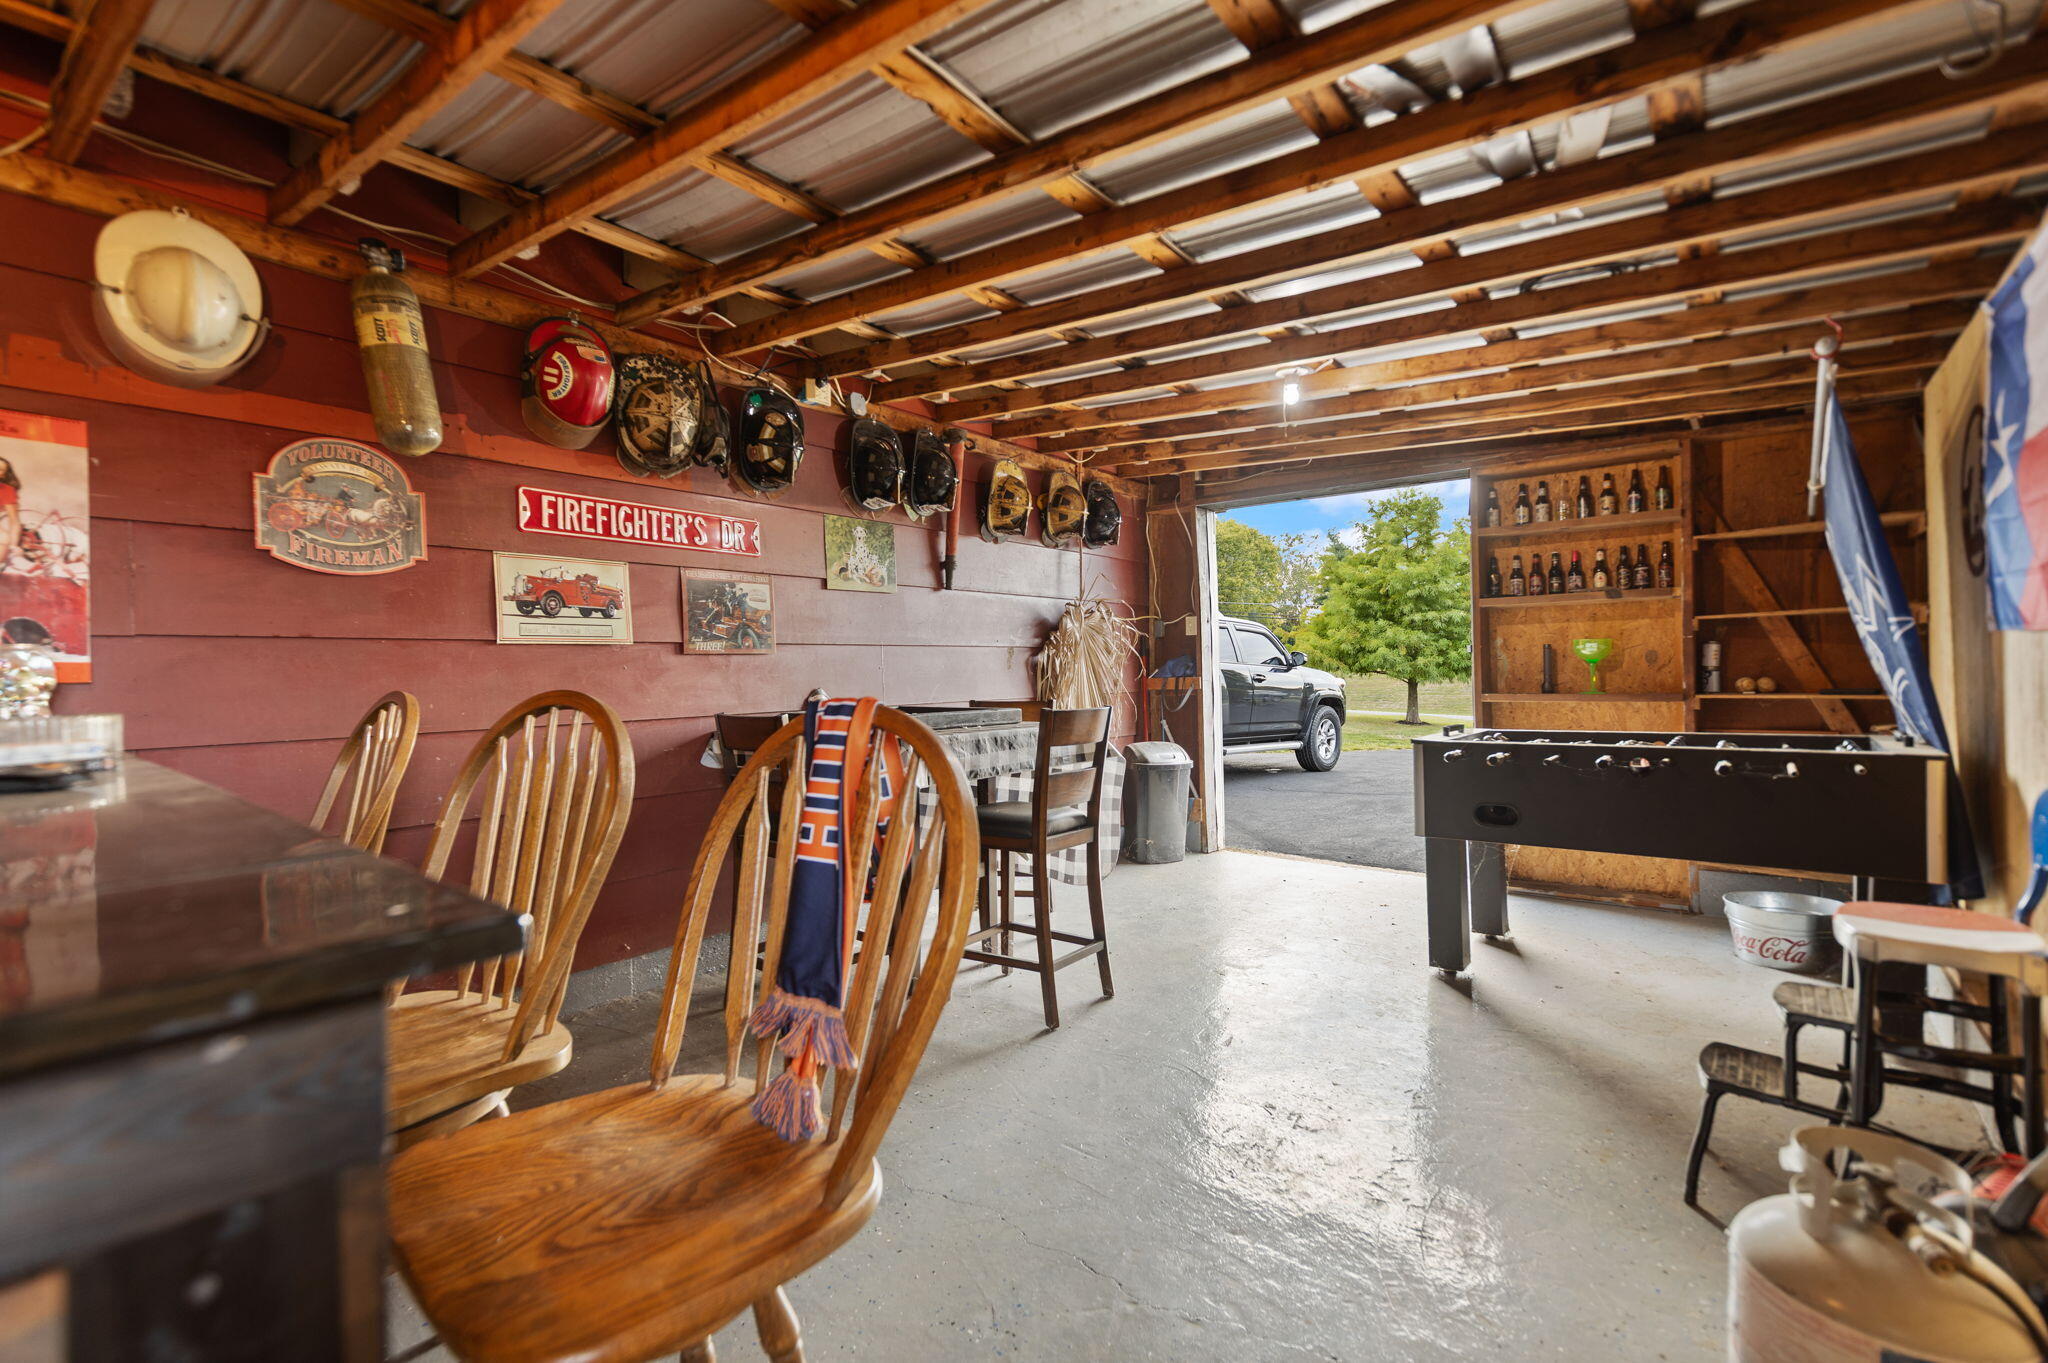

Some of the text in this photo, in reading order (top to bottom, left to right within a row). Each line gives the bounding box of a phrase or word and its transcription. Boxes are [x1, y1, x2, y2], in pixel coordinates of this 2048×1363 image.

[373, 316, 387, 342] SCOTT
[408, 320, 420, 345] SCOTT
[551, 354, 571, 398] FIREFIGHTER
[286, 443, 395, 482] VOLUNTEER
[541, 494, 746, 551] FIREFIGHTER'S DR
[288, 534, 404, 566] FIREMAN
[695, 641, 726, 652] THREE!
[1735, 932, 1811, 964] oca-Cola
